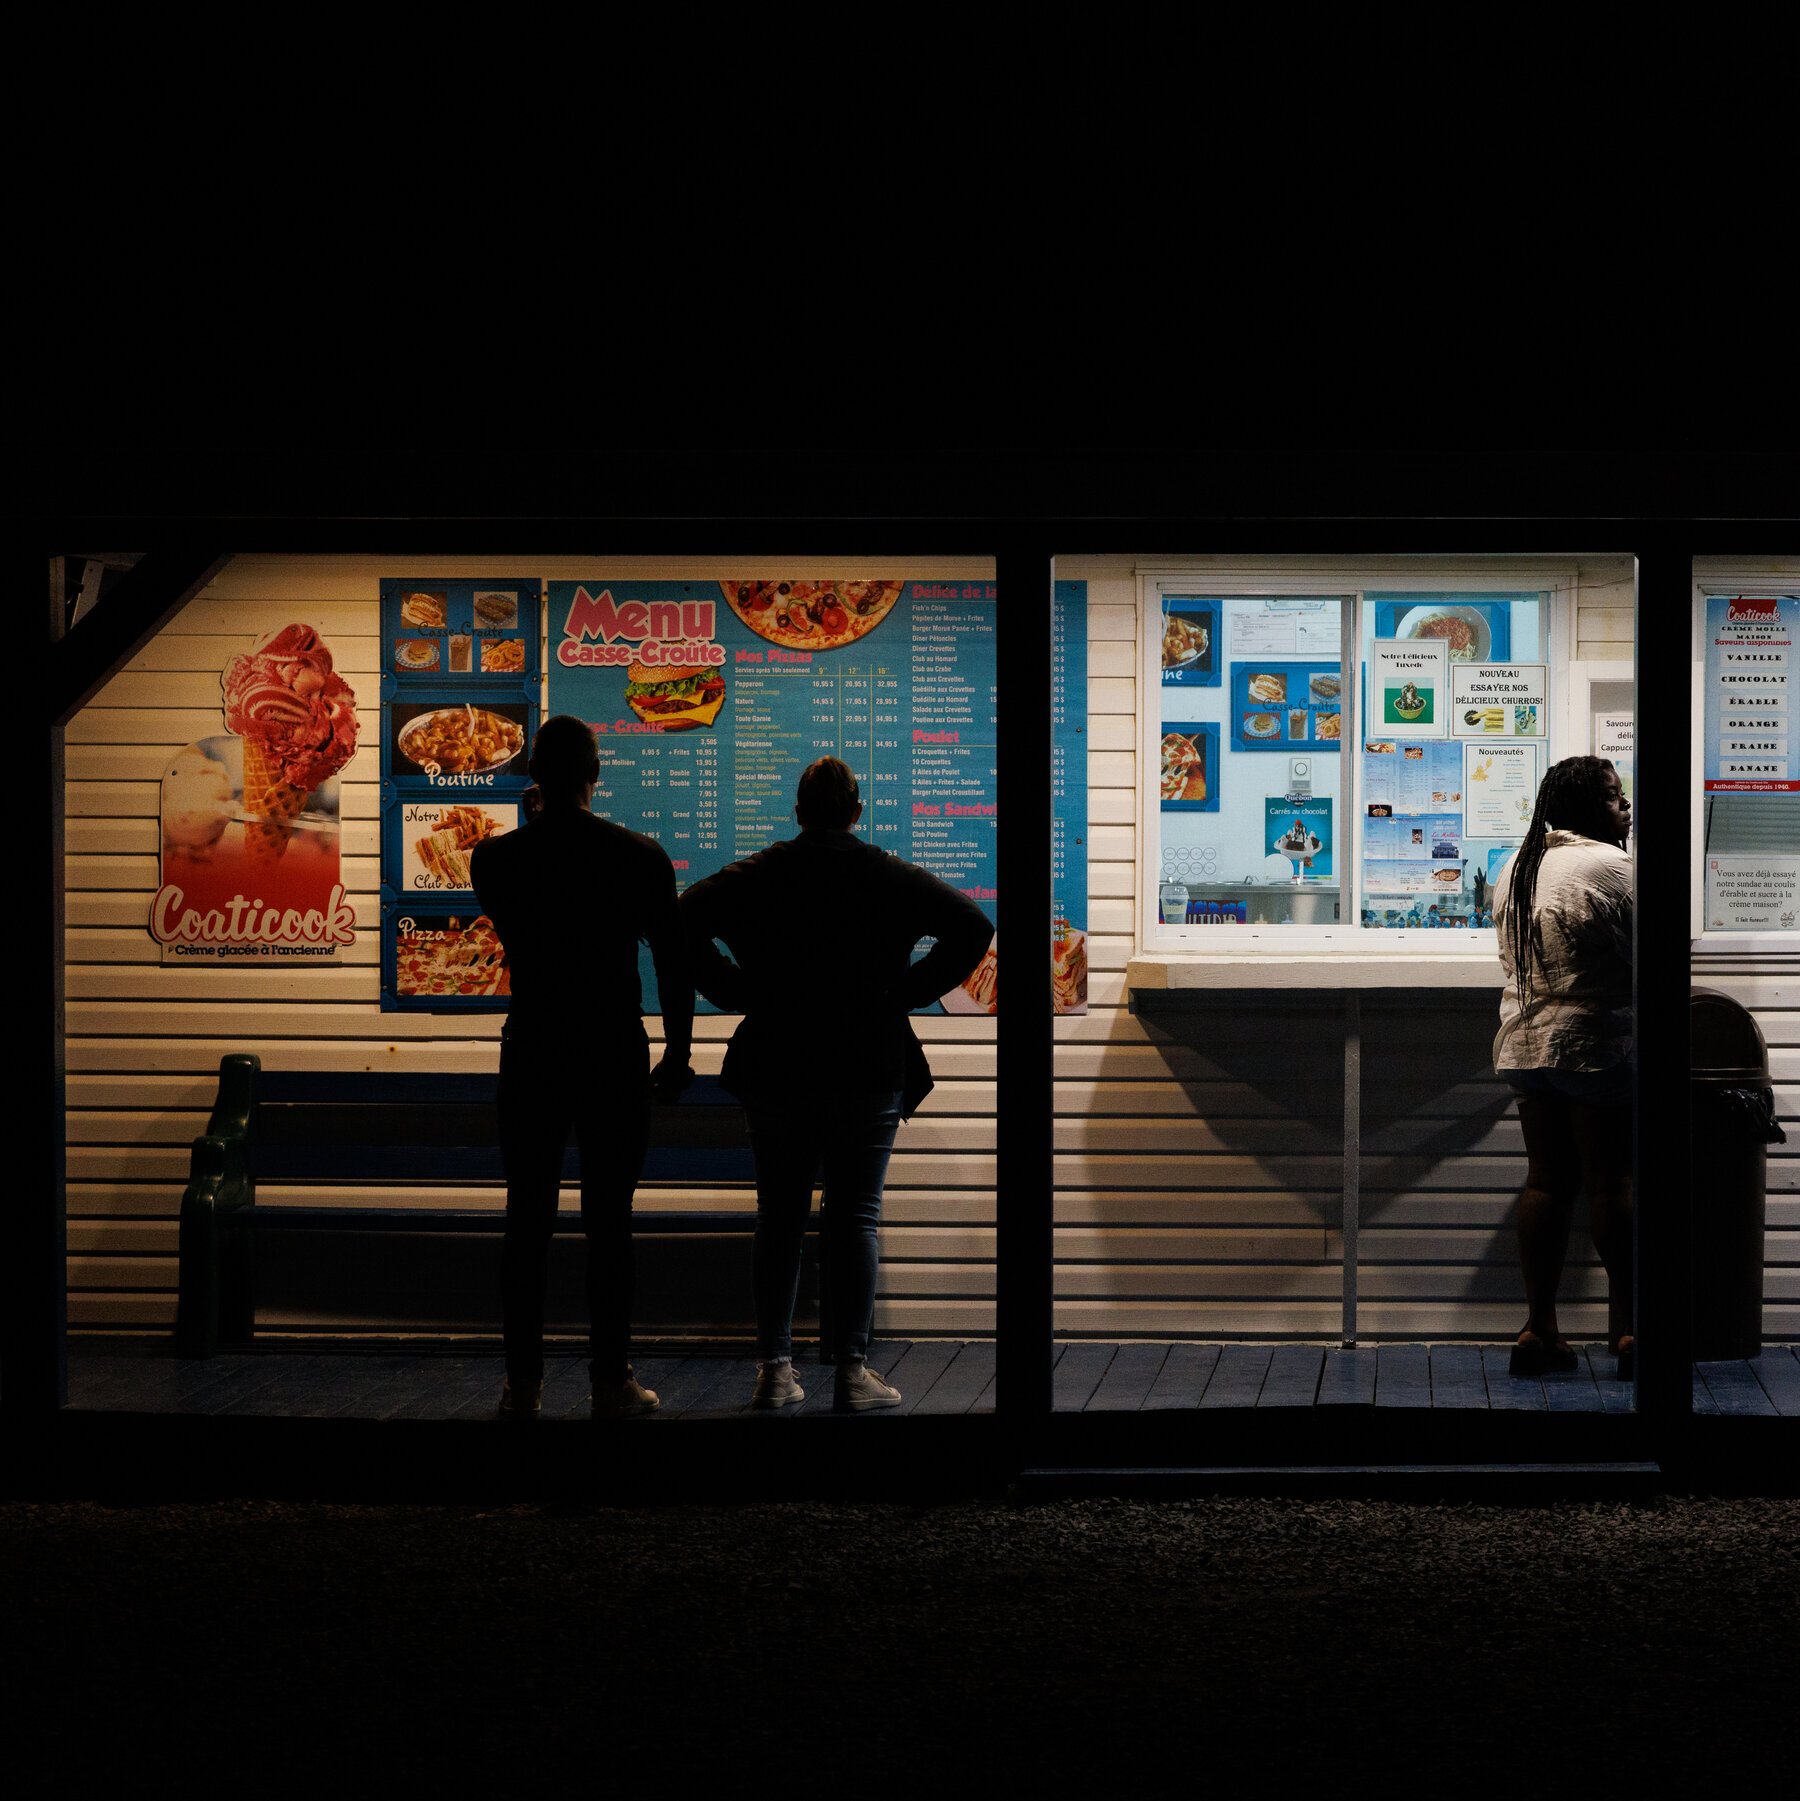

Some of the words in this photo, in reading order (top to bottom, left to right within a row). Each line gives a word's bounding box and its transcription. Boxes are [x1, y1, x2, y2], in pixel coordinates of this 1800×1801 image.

[912, 584, 958, 599] Délice
[962, 584, 982, 599] de
[564, 586, 716, 644] Menu
[1726, 606, 1781, 622] Coaticook
[912, 625, 932, 633] Burger
[1714, 638, 1745, 646] Saveurs
[558, 638, 726, 666] Casse-Croûte
[735, 649, 763, 664] Nos
[767, 649, 812, 664] Pizzas
[1479, 670, 1520, 678] NOUVEAU
[735, 680, 764, 688] Pepperoni
[1470, 684, 1510, 692] ESSAYER
[1512, 684, 1529, 692] NOS
[1455, 695, 1500, 705] DÉLICIEUX
[1501, 697, 1543, 705] CHURROS!
[1729, 697, 1779, 705] ÉRABLE
[912, 729, 960, 743] Poulet
[735, 740, 773, 748] Végétarienne
[917, 748, 948, 756] Croquettes
[1478, 748, 1524, 756] Nouveautés
[1601, 744, 1633, 755] Cappucc
[920, 758, 951, 766] Croquettes
[424, 761, 495, 787] Poutine
[735, 773, 757, 781] Spécial
[1284, 793, 1313, 802] Québon
[912, 801, 941, 816] Nos
[944, 801, 998, 816] Sandwi
[405, 806, 439, 822] Notre
[923, 851, 955, 859] Hamburger
[925, 861, 944, 869] Burger
[1716, 870, 1736, 878] Vous
[1755, 870, 1771, 880] déjà
[1772, 871, 1796, 880] essayé
[414, 874, 442, 889] Club
[446, 877, 474, 890] San
[1736, 880, 1762, 888] sundae
[1774, 880, 1796, 888] coulis
[1719, 890, 1748, 898] d'érable
[1779, 890, 1784, 898] à
[1785, 890, 1792, 898] la
[1728, 900, 1750, 908] crème
[1752, 900, 1782, 908] maison?
[152, 884, 356, 941] Coaticook
[398, 916, 446, 941] Pizza
[174, 944, 215, 955] Crème
[218, 945, 258, 957] glacée
[260, 944, 270, 955] à
[271, 944, 335, 955] l'ancienne
